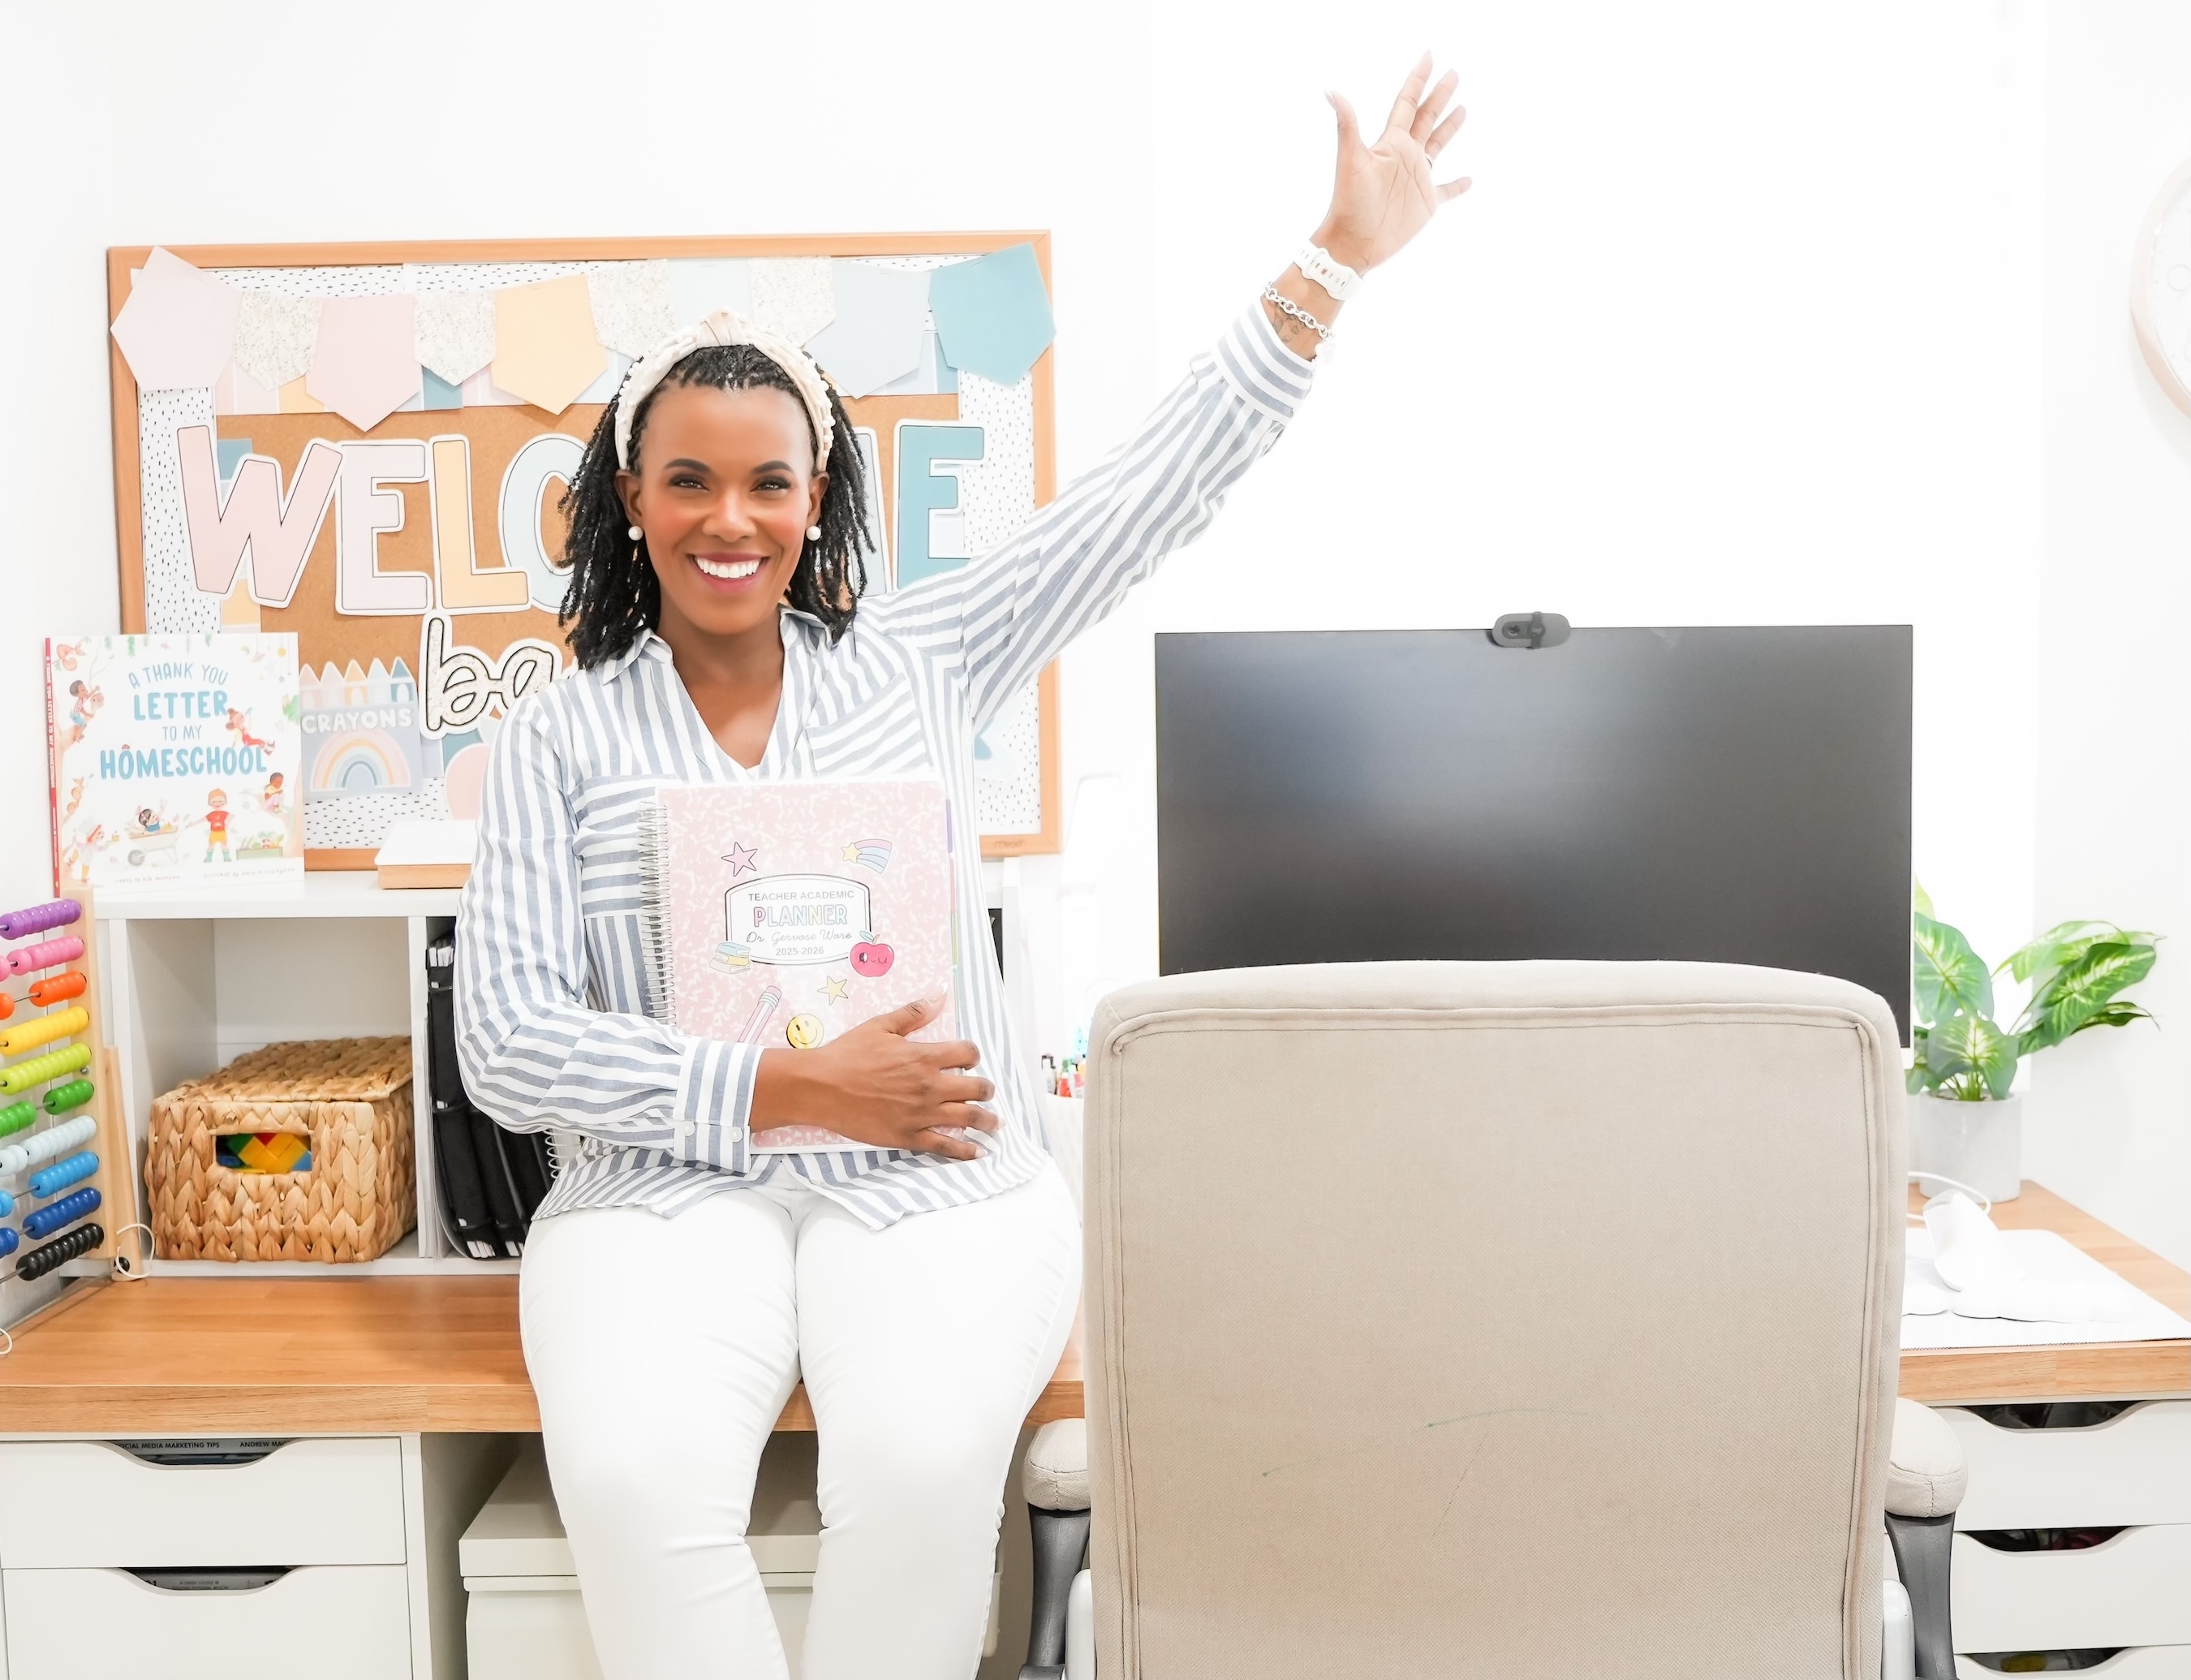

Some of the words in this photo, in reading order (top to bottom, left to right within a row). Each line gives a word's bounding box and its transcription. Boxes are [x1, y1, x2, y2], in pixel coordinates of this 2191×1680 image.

[128, 672, 140, 689] A
[142, 662, 193, 683] THANK
[201, 664, 228, 686] YOU
[133, 690, 229, 721] LETTER
[162, 726, 177, 741] TO
[183, 725, 202, 740] MY
[301, 708, 412, 734] CRAYONS
[100, 746, 267, 780] HOMESCHOOL
[748, 892, 797, 902] TEACHER
[800, 890, 854, 899] ACADEMIC
[753, 903, 848, 928] PLANNER
[746, 931, 766, 943] Dr.
[771, 932, 817, 946] Gervase
[820, 928, 853, 941] Ware
[776, 946, 824, 956] 2025-2026
